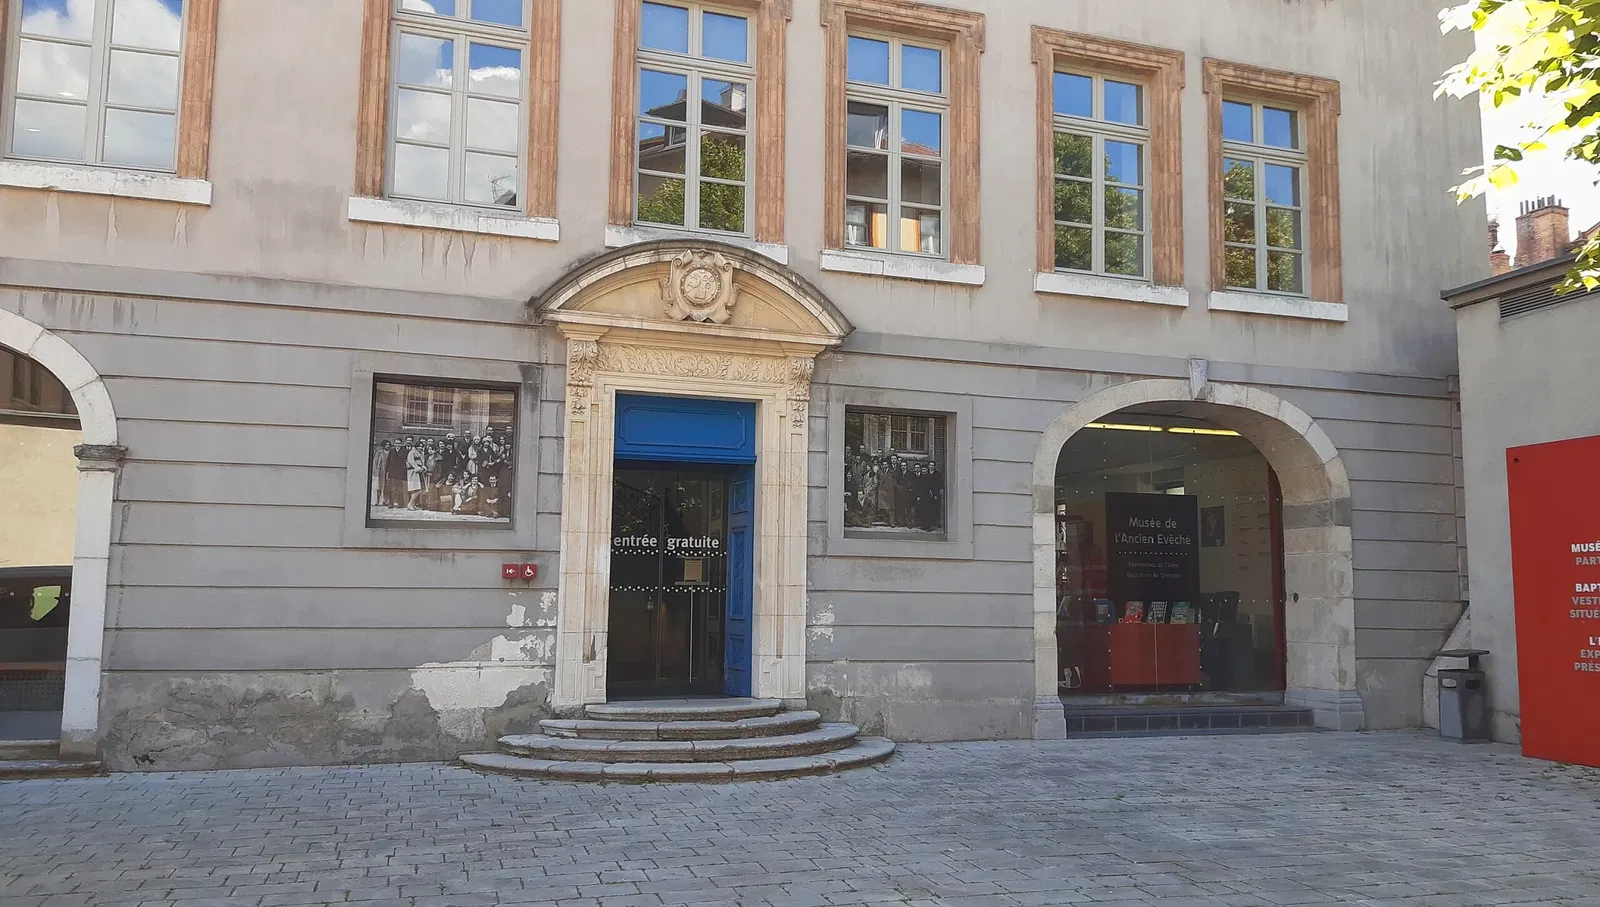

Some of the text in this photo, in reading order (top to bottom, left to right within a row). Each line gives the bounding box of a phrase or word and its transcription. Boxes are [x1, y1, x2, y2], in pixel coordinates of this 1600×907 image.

[1129, 516, 1177, 529] Musée de
[613, 533, 720, 550] entrée gratuite
[1114, 532, 1191, 545] l'Ancien Evêché
